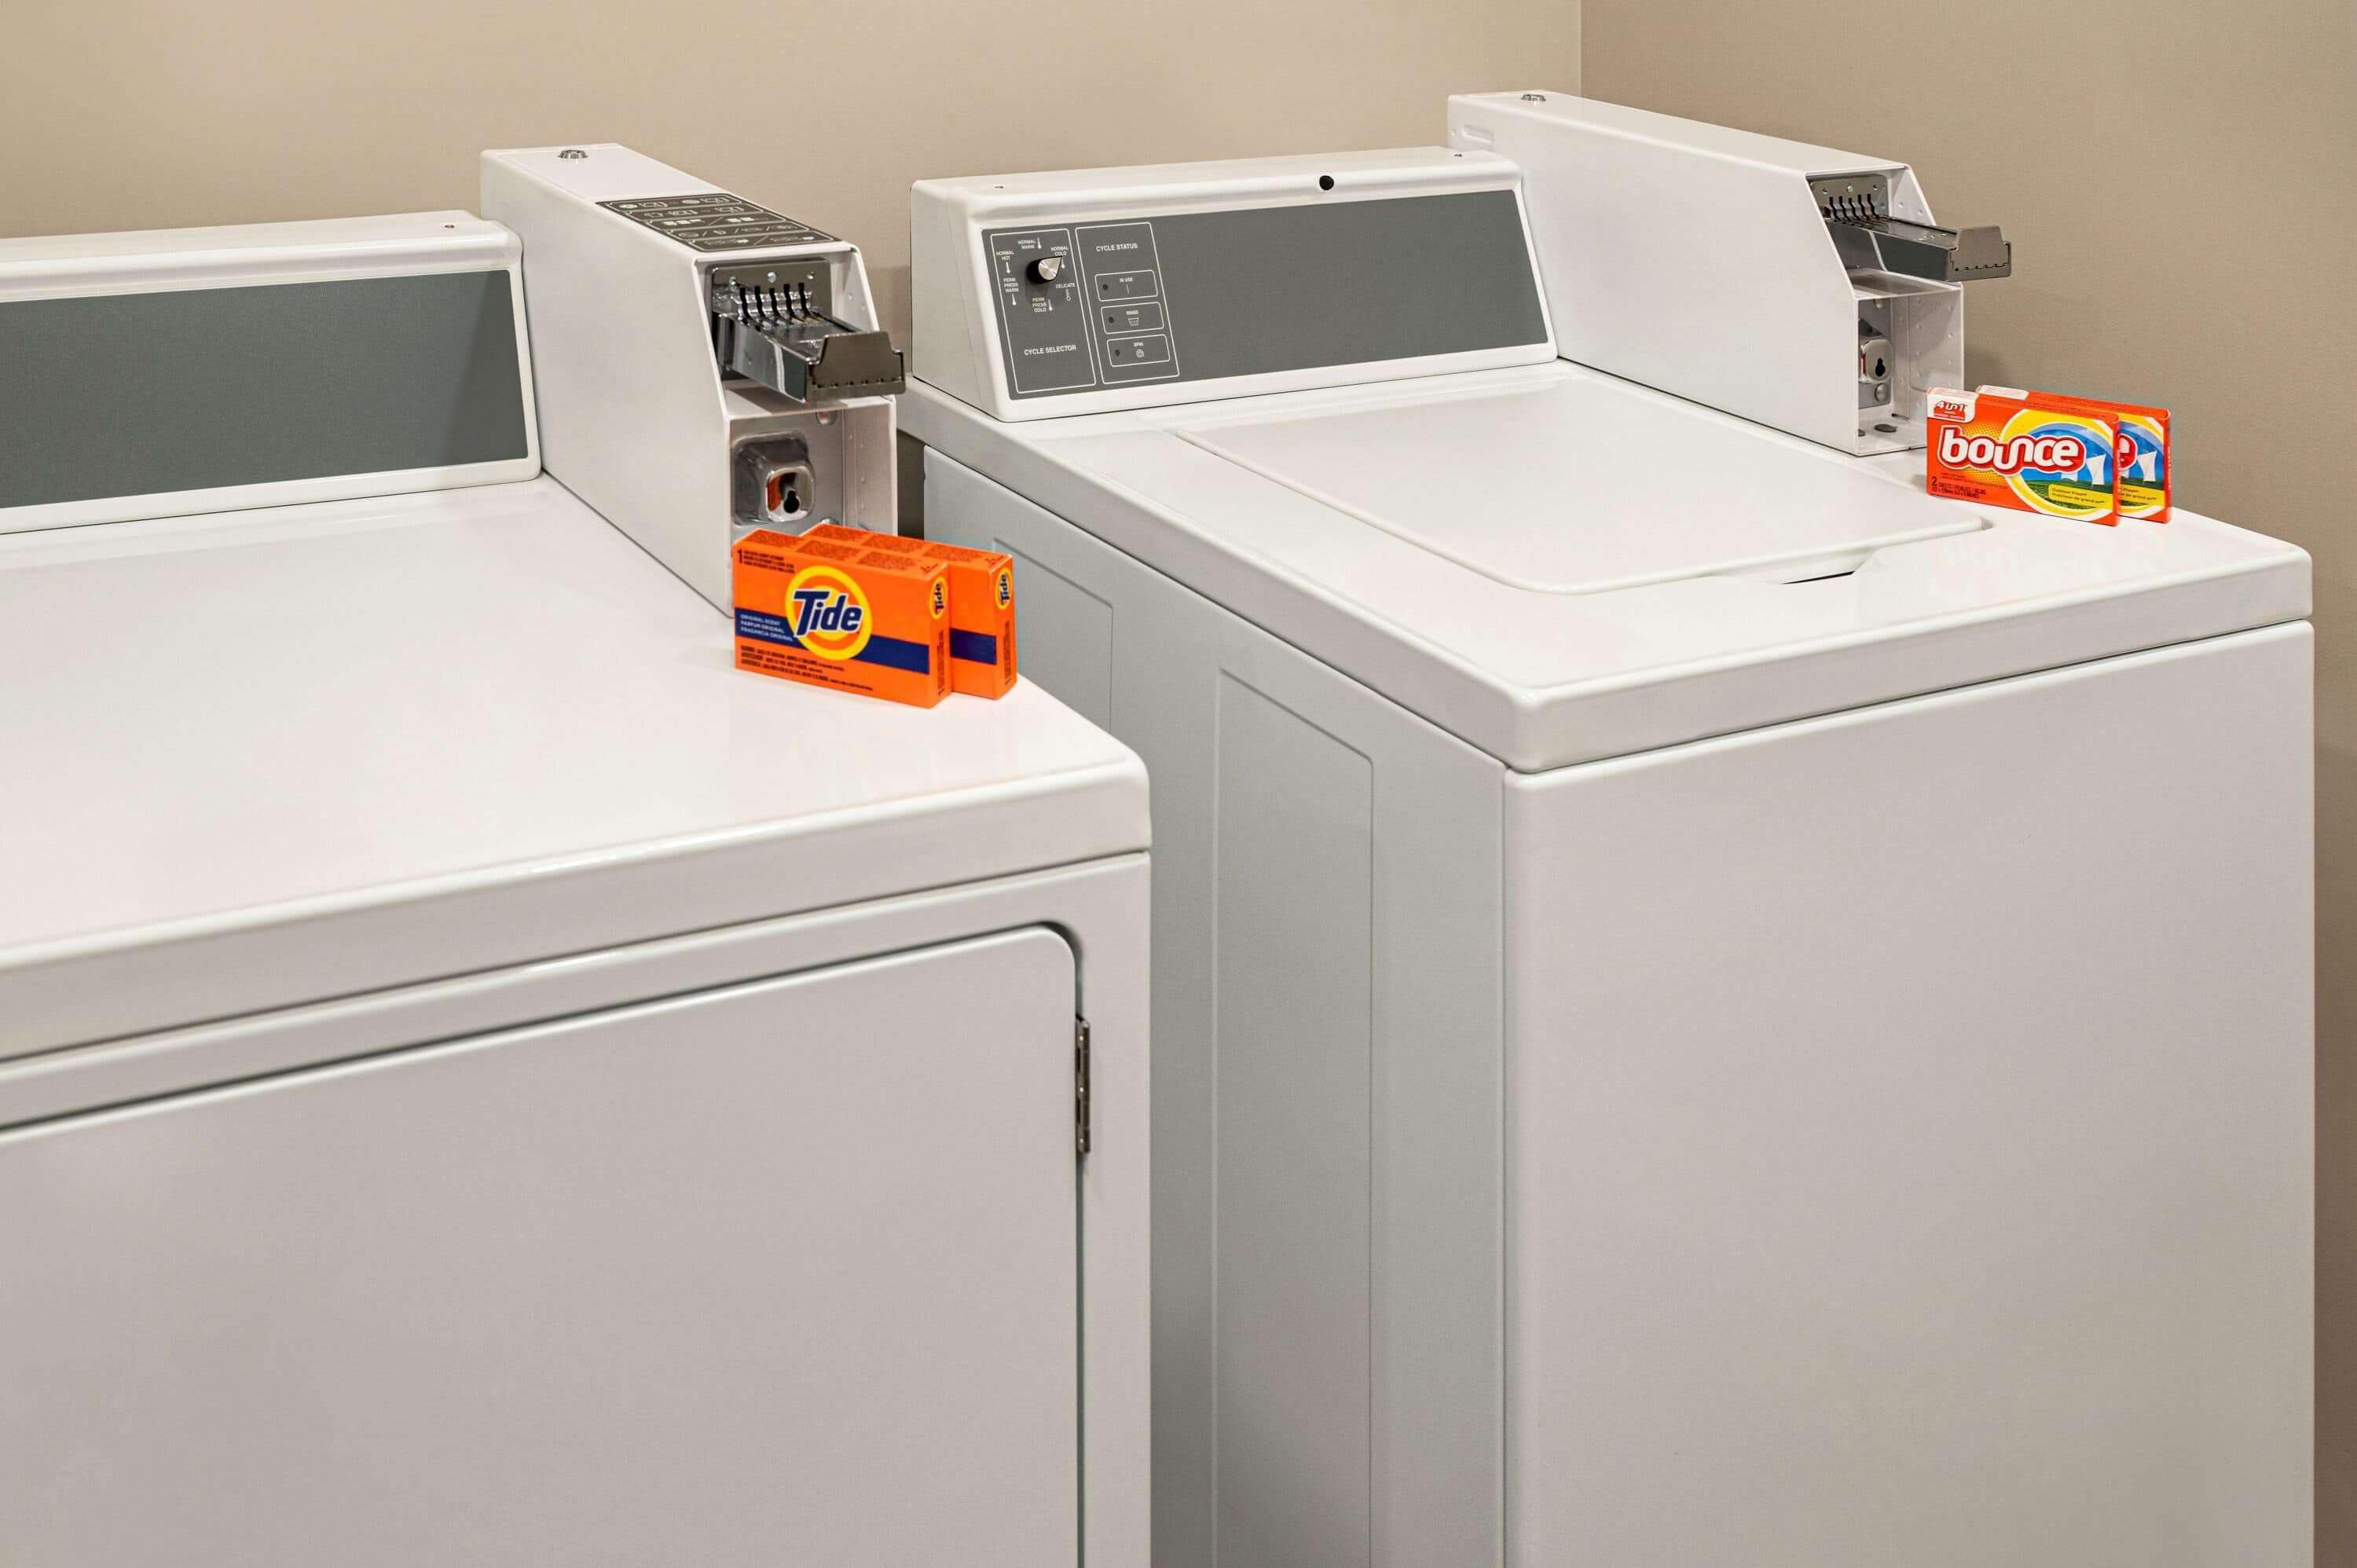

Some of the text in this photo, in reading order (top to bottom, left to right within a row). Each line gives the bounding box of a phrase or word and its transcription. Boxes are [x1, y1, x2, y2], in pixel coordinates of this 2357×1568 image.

[1024, 345, 1077, 356] CYCLE SELECTOR
[1939, 427, 2081, 471] bounce
[1931, 476, 1937, 487] 2
[737, 549, 743, 564] 1
[934, 583, 944, 616] Tide
[999, 574, 1010, 606] Tide
[740, 614, 764, 623] ORIGINAL
[793, 590, 863, 636] Tide
